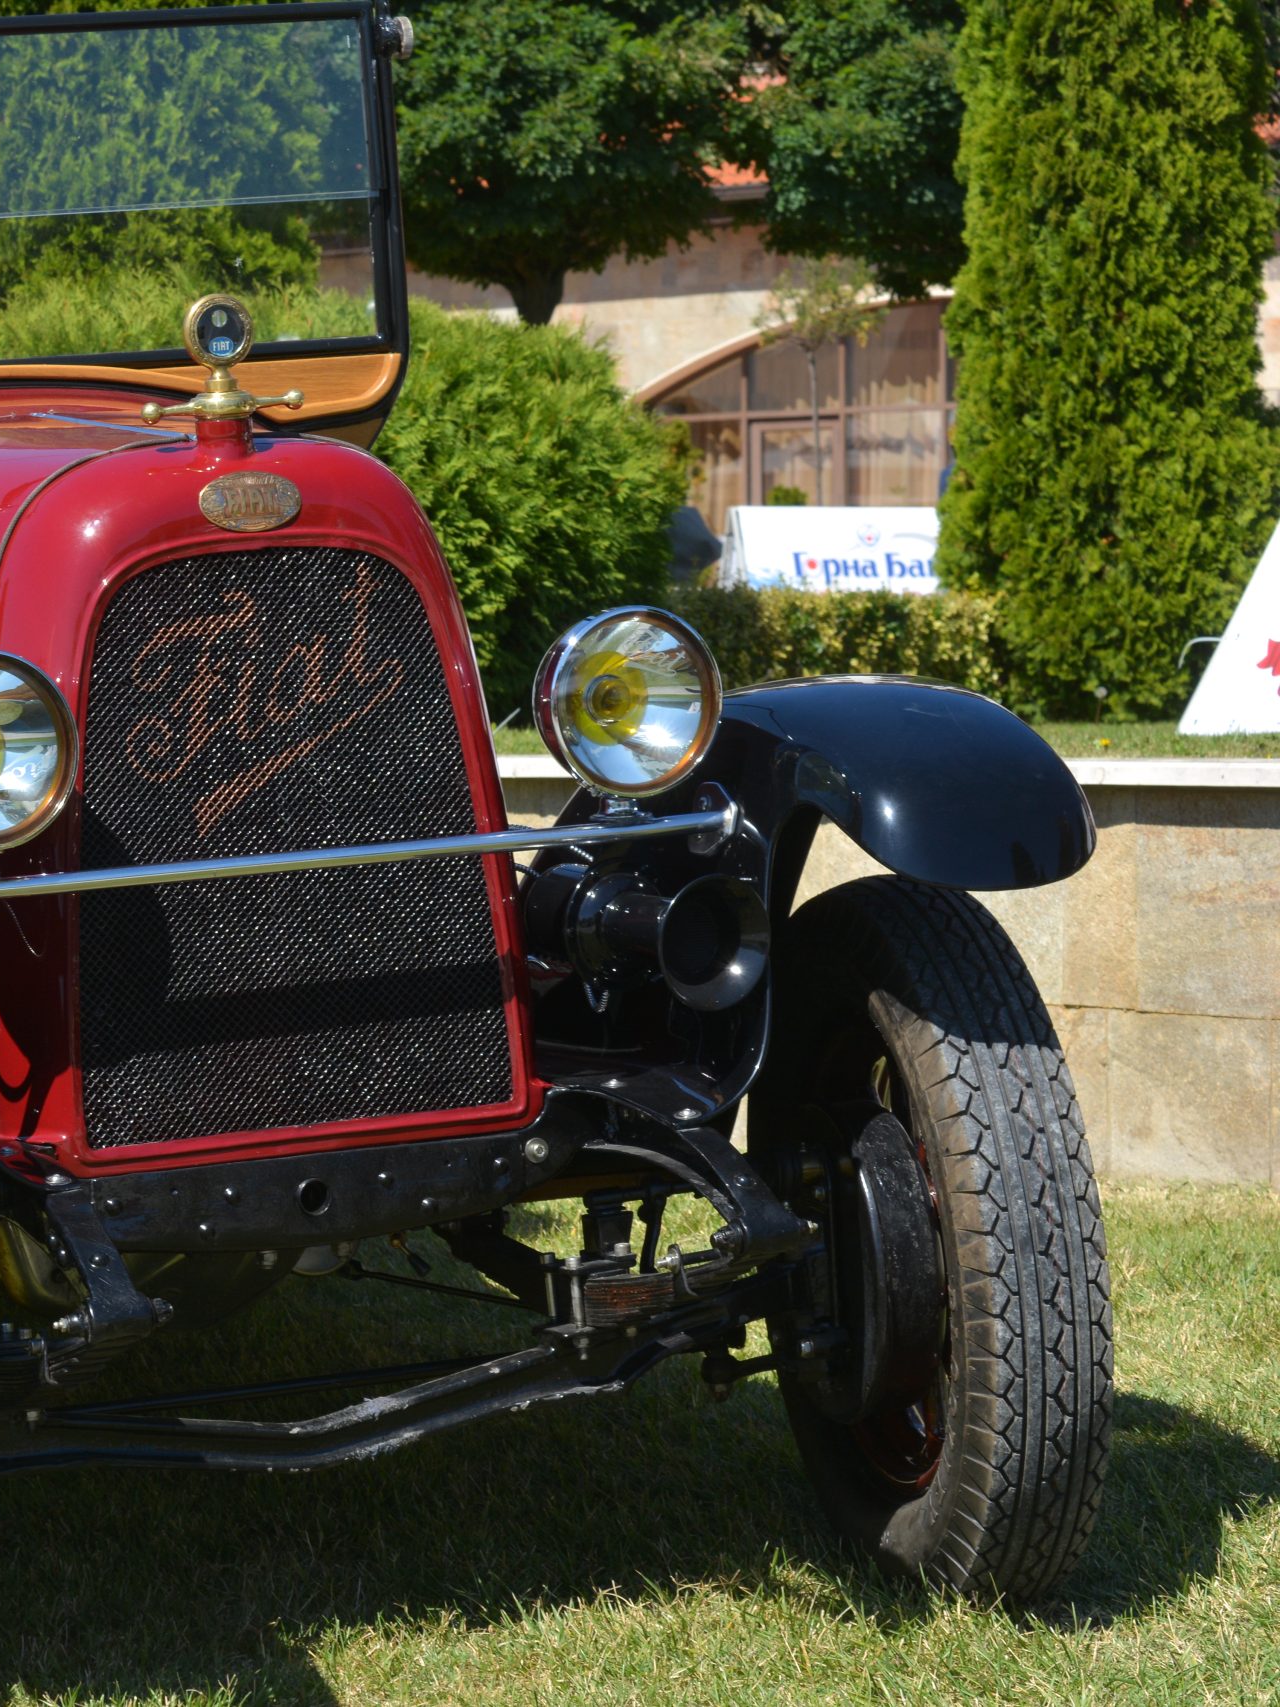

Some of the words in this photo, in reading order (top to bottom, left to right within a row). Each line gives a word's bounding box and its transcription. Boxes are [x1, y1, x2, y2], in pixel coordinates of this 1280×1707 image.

[212, 340, 231, 352] FIAT
[223, 487, 278, 516] FIAT
[125, 561, 404, 836] Fiat
